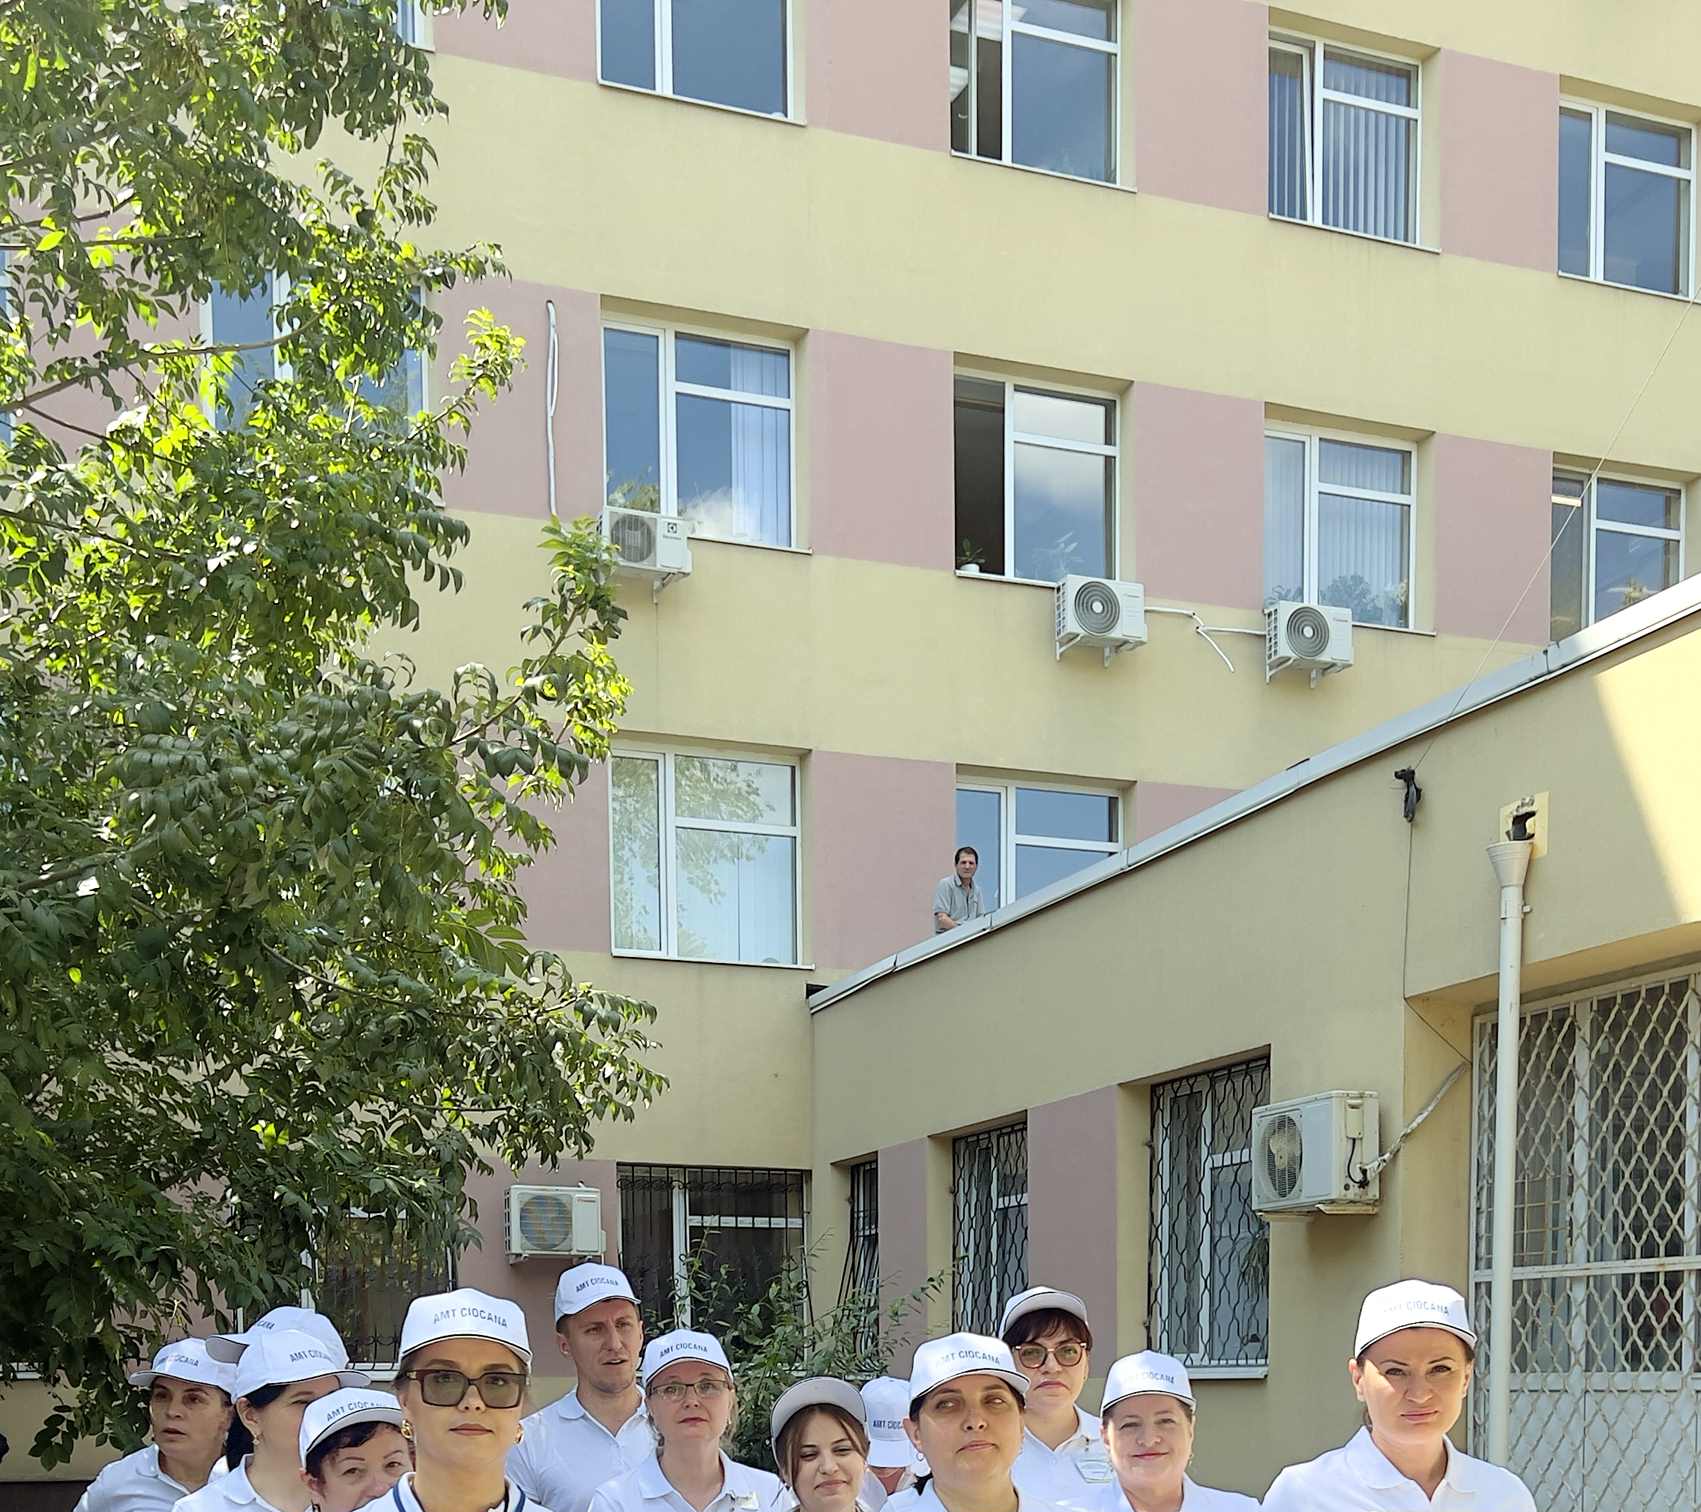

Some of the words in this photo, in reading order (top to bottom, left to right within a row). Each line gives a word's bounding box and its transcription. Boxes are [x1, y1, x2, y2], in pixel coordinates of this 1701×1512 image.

[575, 1280, 590, 1293] AMT
[1406, 1300, 1450, 1316] CIOCANA
[433, 1308, 457, 1325] AMT
[459, 1306, 509, 1329] CIOCANA
[289, 1350, 308, 1363] AMT
[660, 1345, 675, 1358] AMT
[675, 1342, 708, 1354] CIOCANA
[958, 1350, 1001, 1365] CIOCANA
[326, 1407, 346, 1422] AMT
[872, 1419, 886, 1429] AMT
